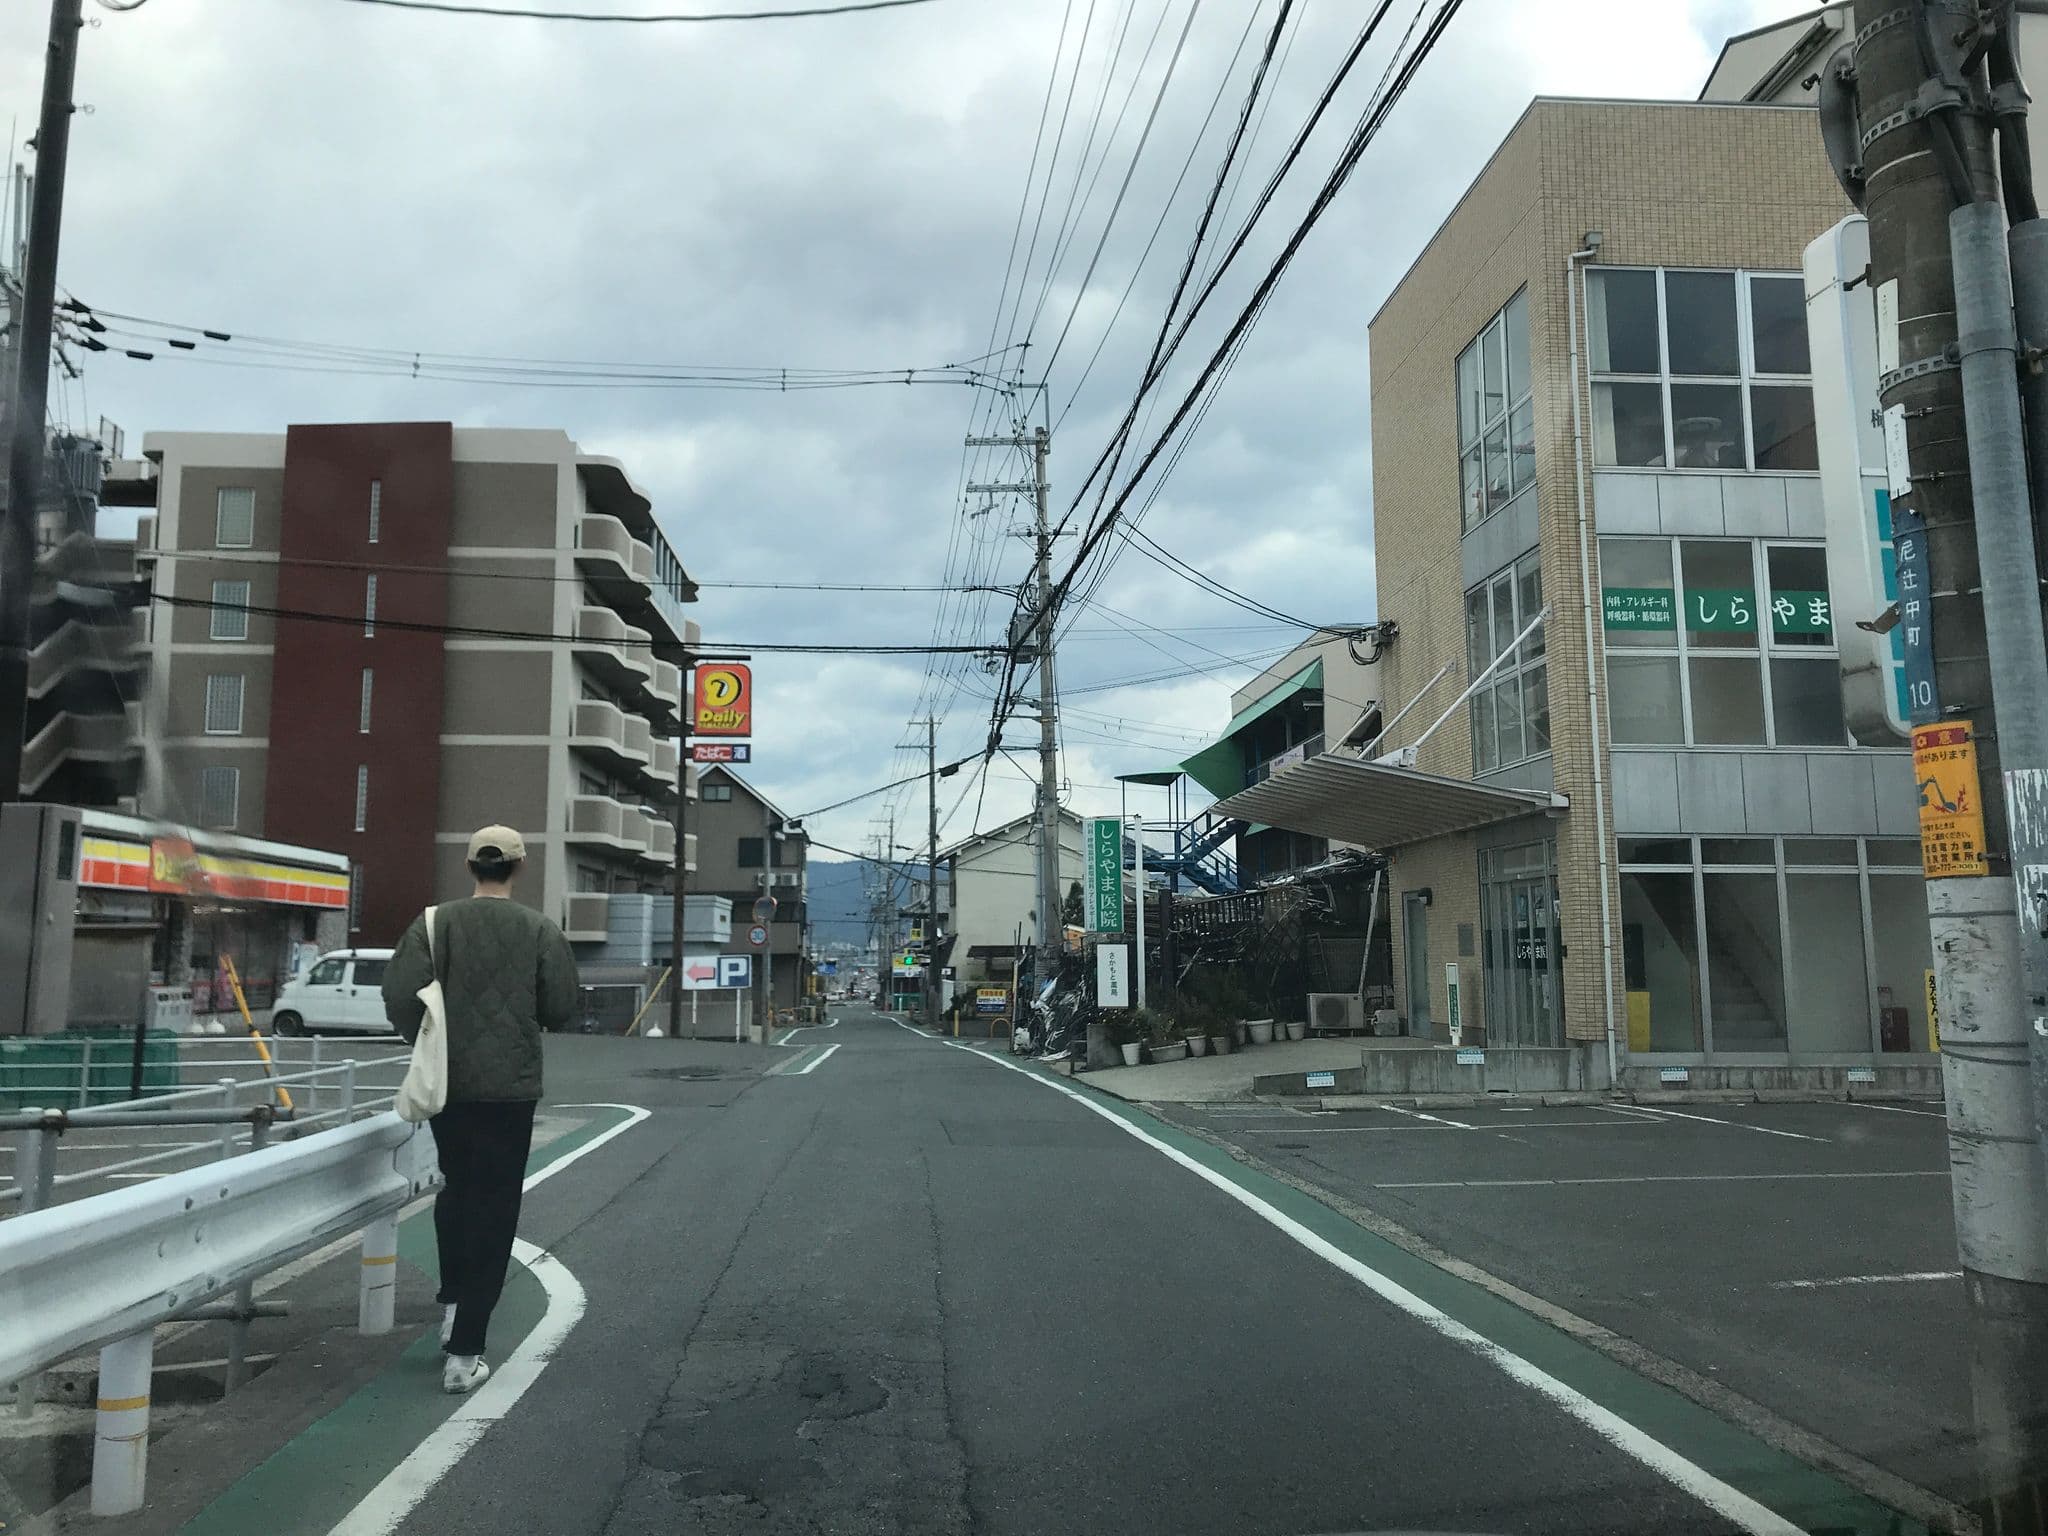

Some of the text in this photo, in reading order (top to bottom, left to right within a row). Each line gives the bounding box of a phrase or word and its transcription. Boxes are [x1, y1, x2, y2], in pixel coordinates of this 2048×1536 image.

[1909, 681, 1932, 708] 10
[699, 709, 745, 729] Daily
[695, 746, 731, 760] たばこ
[1100, 823, 1118, 928] しらやま医院
[720, 957, 747, 987] P
